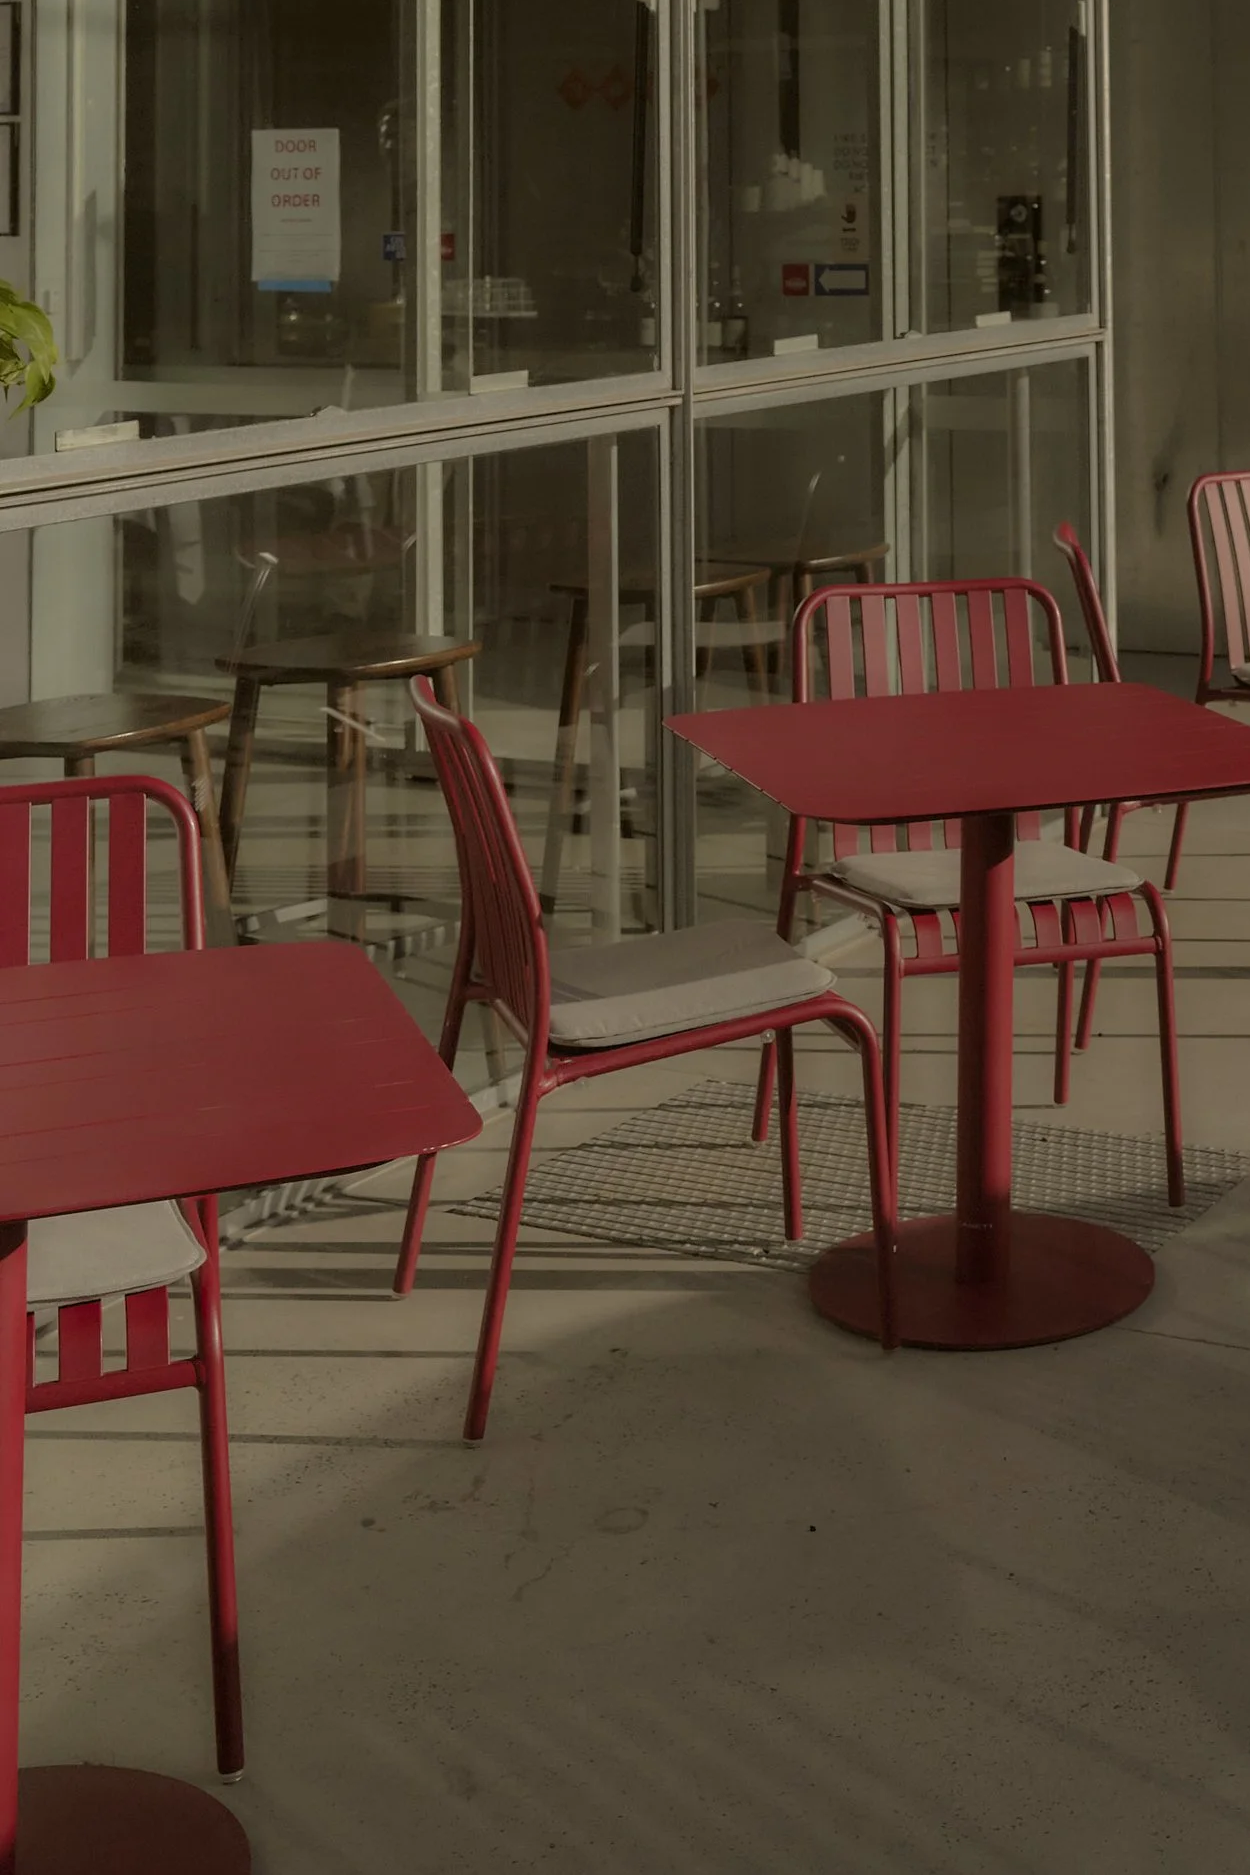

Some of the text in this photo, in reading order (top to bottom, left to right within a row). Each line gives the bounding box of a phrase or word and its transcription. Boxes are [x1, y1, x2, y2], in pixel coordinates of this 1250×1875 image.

[274, 139, 317, 153] DOOR
[270, 167, 322, 181] OUT OF
[271, 193, 321, 208] ORDER
